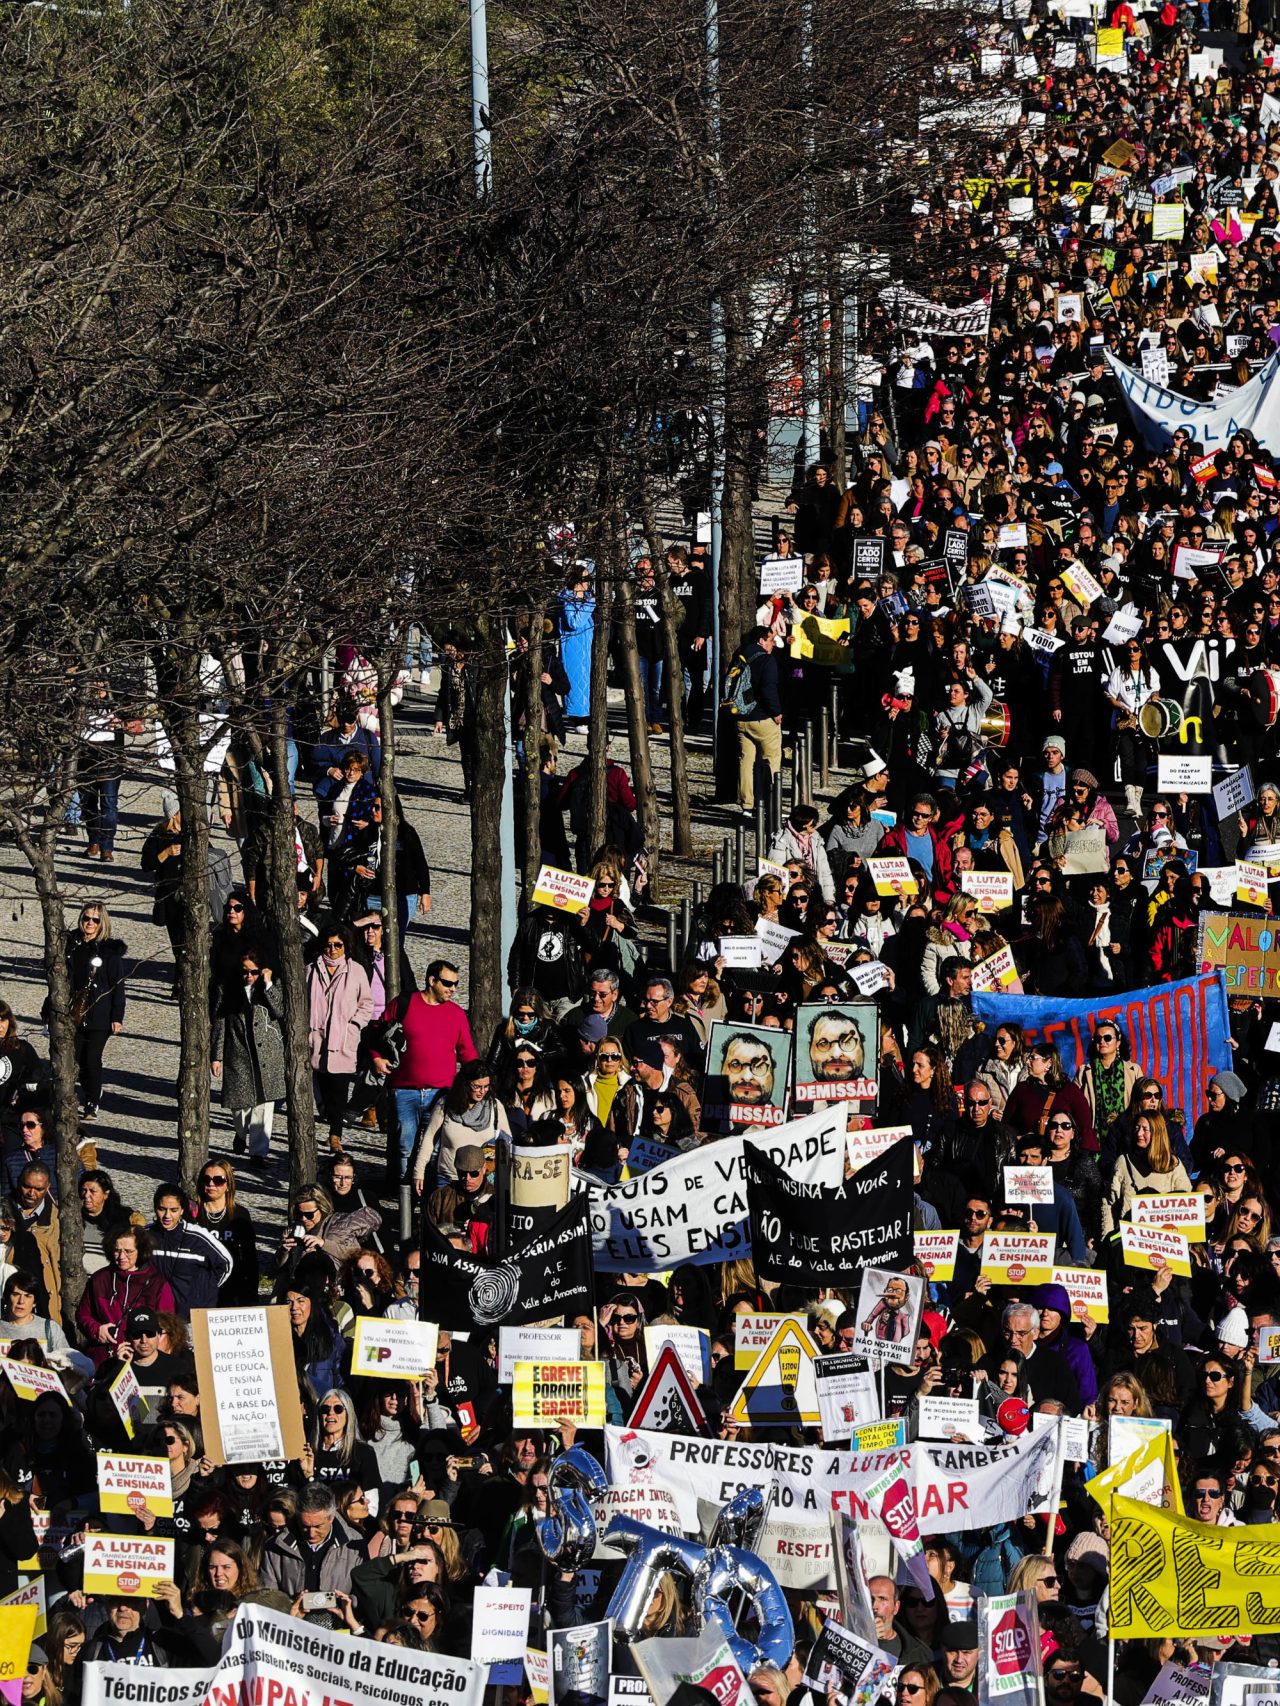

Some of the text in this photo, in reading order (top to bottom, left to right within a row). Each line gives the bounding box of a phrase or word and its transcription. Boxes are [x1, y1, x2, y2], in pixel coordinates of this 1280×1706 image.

[948, 541, 965, 549] LADO
[947, 548, 965, 556] CERTO
[1031, 633, 1055, 650] TODO
[1069, 652, 1094, 660] ESTOU
[555, 873, 590, 889] LUTAR
[550, 883, 586, 899] ENSINAR
[796, 1078, 879, 1101] DEMISSÃO
[706, 1103, 784, 1124] DEMISSÃO
[685, 1176, 704, 1191] DE
[835, 1171, 888, 1200] A VOAR
[1138, 1198, 1198, 1210] A LUTAR
[620, 1203, 688, 1231] USAM
[1138, 1213, 1199, 1223] A ENSINAR
[432, 1217, 588, 1266] SUA ASSIM!
[607, 1234, 671, 1260] ELES
[990, 1238, 1048, 1249] A LUTAR
[789, 1251, 898, 1272] do Vale da Amoreira
[989, 1253, 1048, 1263] A ENSINAR
[551, 1278, 561, 1287] do
[521, 1286, 588, 1310] Vale da Amoreira
[209, 1314, 257, 1324] RESPEITEM
[212, 1327, 263, 1336] VALORIZEM
[519, 1333, 562, 1341] PROFESSOR
[874, 1341, 911, 1354] NOS VIRES
[215, 1350, 264, 1360] PROFISSÃO
[877, 1349, 902, 1361] COSTAS!
[214, 1363, 268, 1373] QUE EDUCA,
[230, 1376, 262, 1384] ENSINA
[243, 1388, 262, 1396] QUE
[533, 1384, 582, 1399] PORQUE
[221, 1401, 225, 1410] É
[237, 1400, 259, 1409] BASE
[232, 1412, 267, 1422] NAÇÃO!
[670, 1441, 813, 1476] PROFESSORES
[827, 1458, 840, 1475] A
[104, 1461, 164, 1475] A LUTAR
[105, 1478, 165, 1491] A ENSINAR
[128, 1498, 146, 1506] STOP
[237, 1618, 469, 1693] do Ministério da Educação
[840, 1640, 871, 1662] SOMOS
[306, 1666, 353, 1692] Sociais,
[104, 1676, 189, 1702] Técnicos
